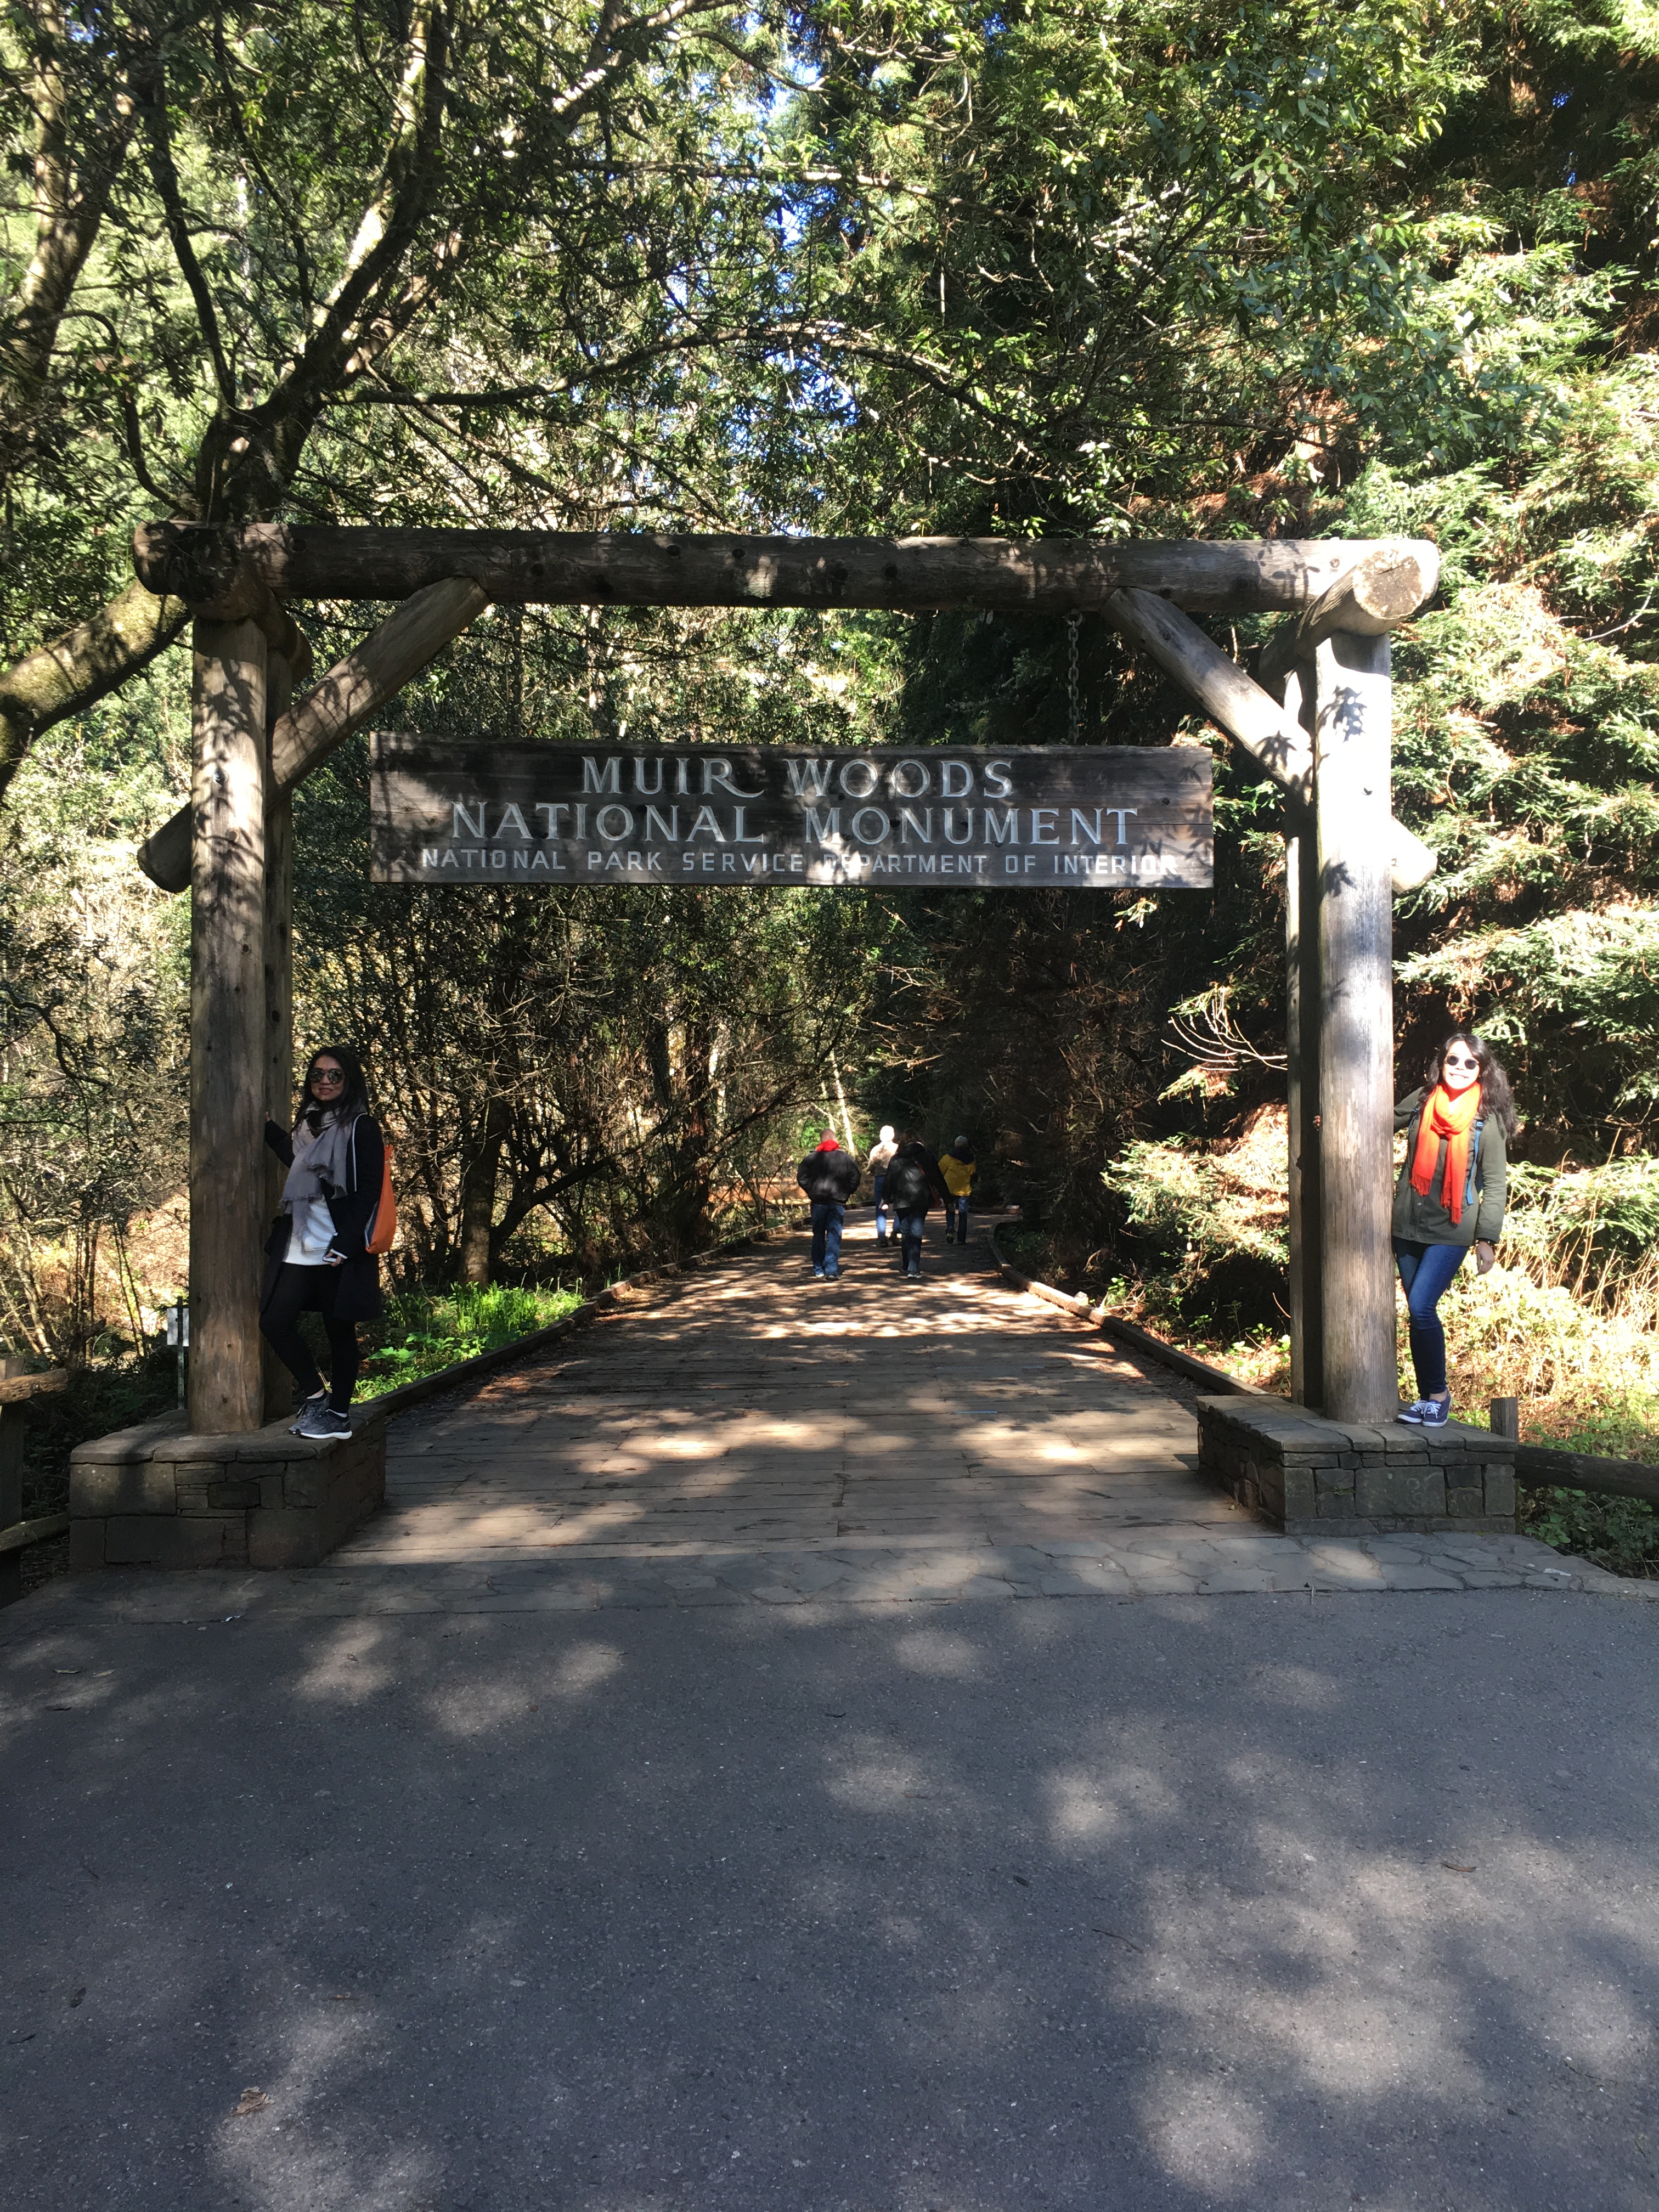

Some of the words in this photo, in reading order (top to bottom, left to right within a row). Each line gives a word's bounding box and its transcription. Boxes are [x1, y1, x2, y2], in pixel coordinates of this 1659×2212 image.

[581, 756, 765, 799] MUIR
[786, 758, 1014, 799] WOODS
[450, 801, 765, 843] NATIONAL
[804, 806, 1138, 845] MONUMENT
[421, 848, 566, 870] NATIONAL
[588, 850, 663, 871] PARK
[682, 851, 804, 873] SERVICE
[823, 854, 988, 873] DEPARTMENT
[1006, 855, 1036, 874] OF
[1054, 854, 1178, 876] INTERIOR
